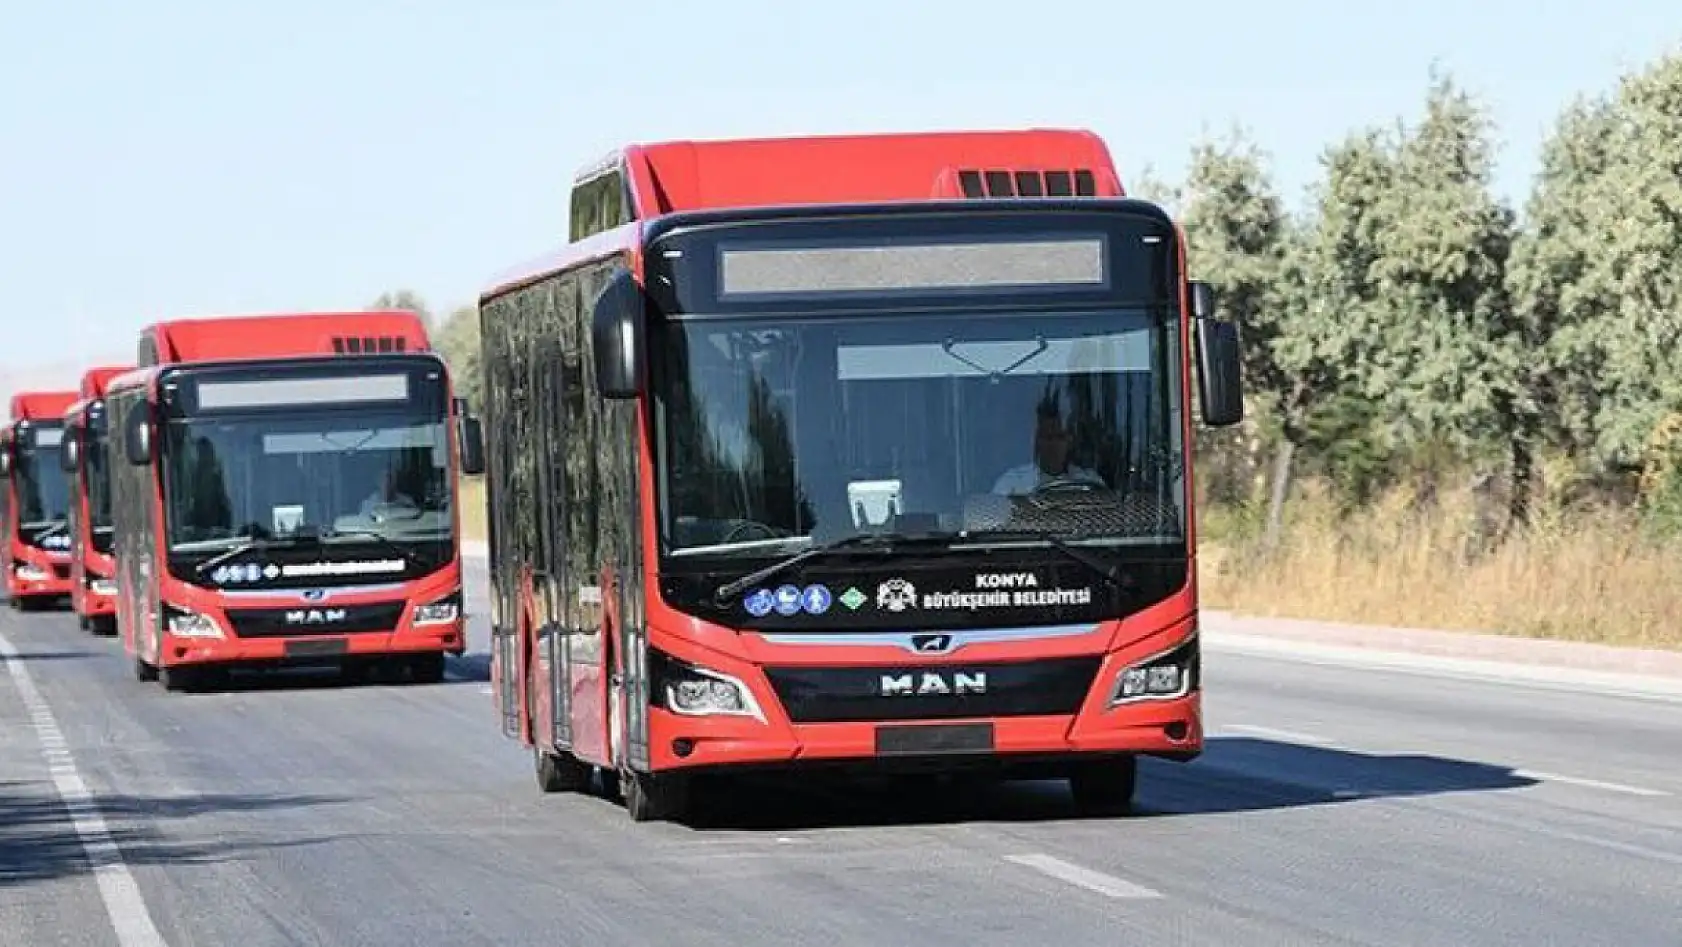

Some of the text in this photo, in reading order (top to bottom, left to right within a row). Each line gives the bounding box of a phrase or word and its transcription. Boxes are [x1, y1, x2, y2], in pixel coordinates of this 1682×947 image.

[976, 573, 1037, 588] KONYA
[923, 587, 1091, 609] BÜYÜKŞEHİR BELEDİYESİ
[286, 609, 346, 622] MAN
[881, 673, 986, 695] MAN
